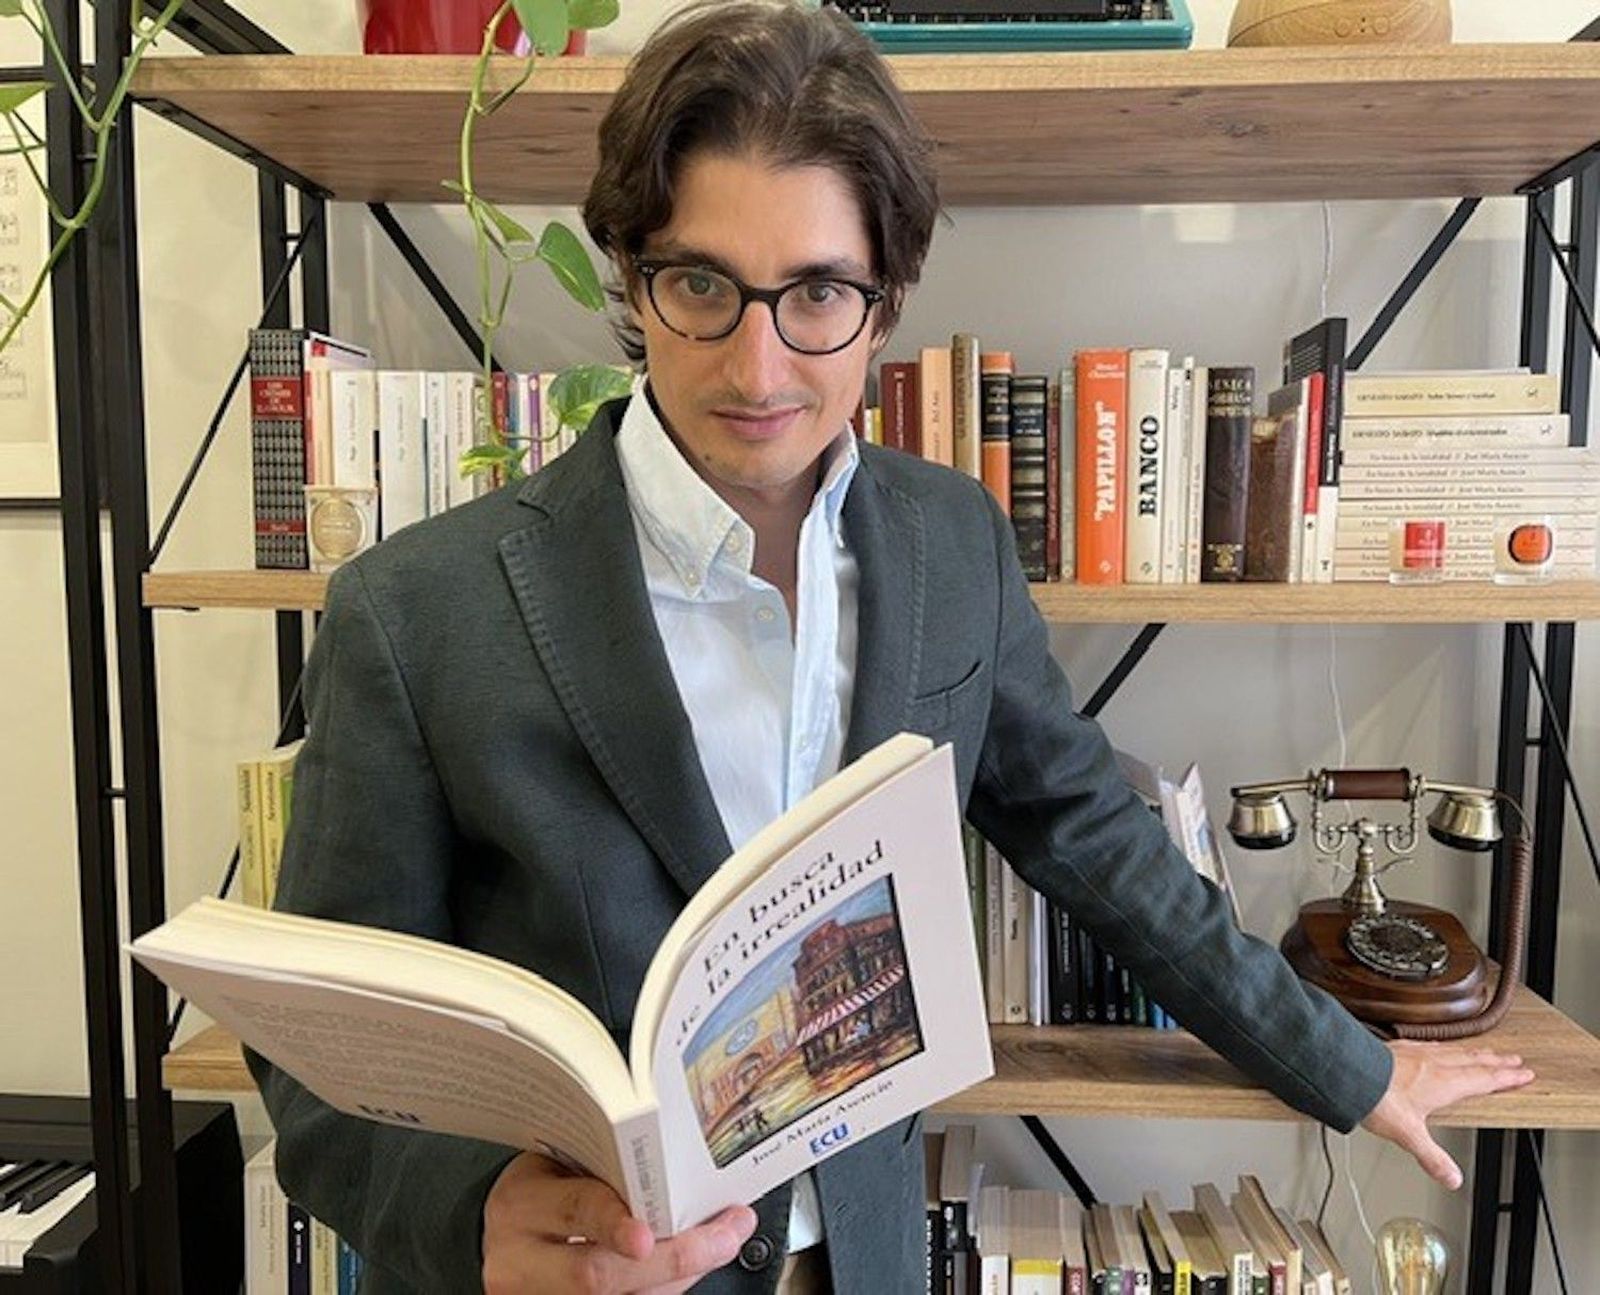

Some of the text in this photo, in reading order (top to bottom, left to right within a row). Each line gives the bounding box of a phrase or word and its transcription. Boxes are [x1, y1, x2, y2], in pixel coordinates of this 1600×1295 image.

[1138, 415, 1161, 518] BANCO
[704, 851, 835, 973] En busca
[707, 968, 732, 996] la
[740, 839, 884, 961] irrealidad
[787, 1115, 831, 1143] María
[809, 1122, 849, 1156] ECU
